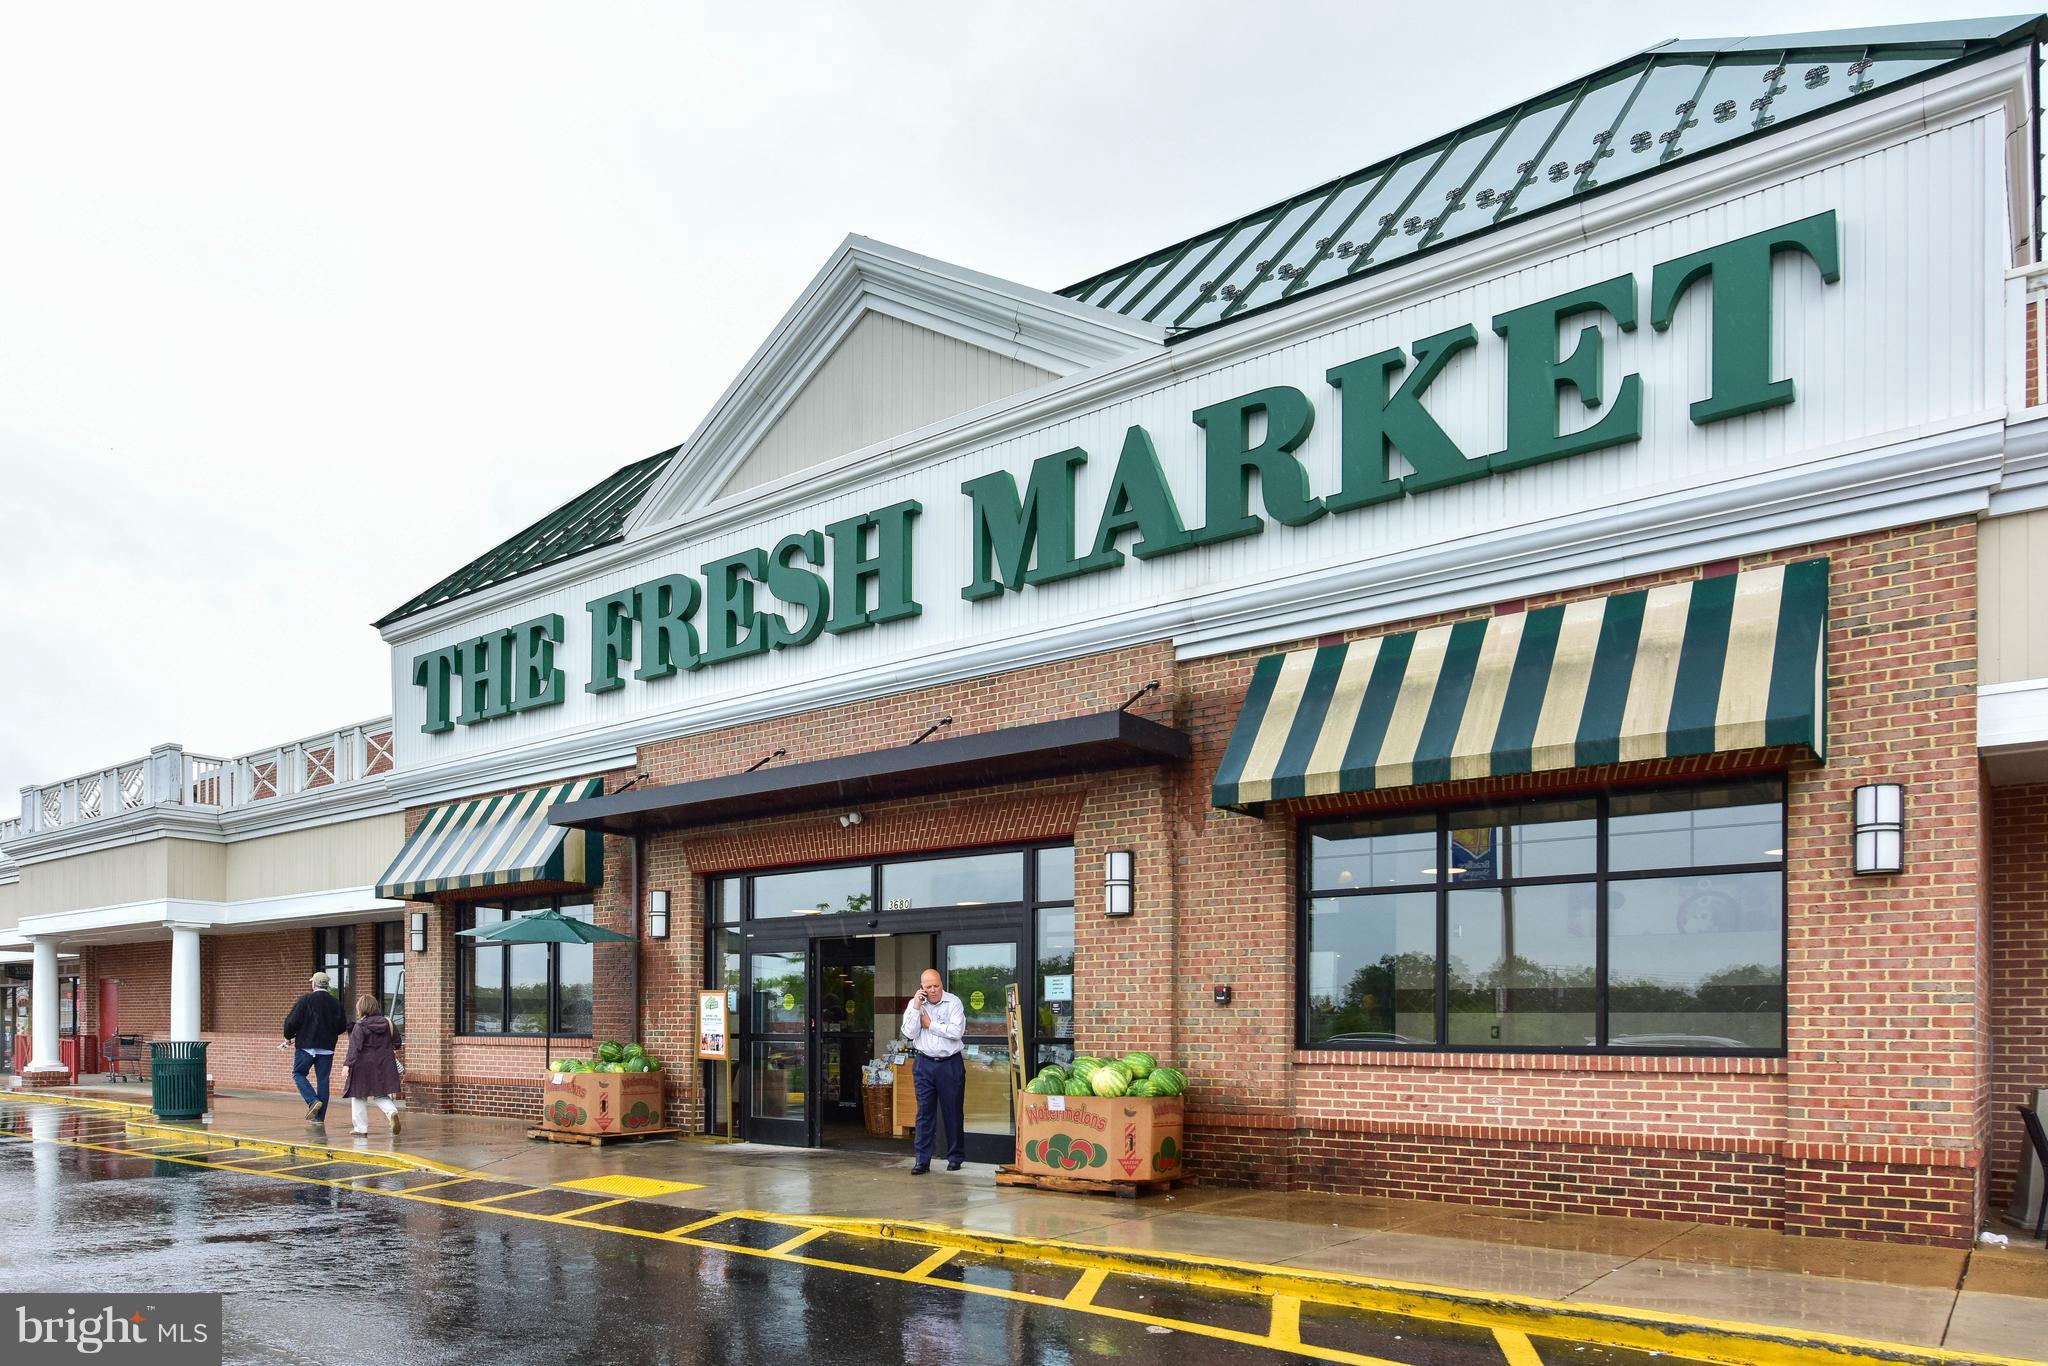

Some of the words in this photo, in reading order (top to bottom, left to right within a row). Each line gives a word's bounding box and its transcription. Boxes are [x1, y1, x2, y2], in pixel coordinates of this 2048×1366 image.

[413, 613, 564, 734] THE
[585, 499, 922, 694] FRESH
[961, 209, 1840, 601] MARKET
[889, 900, 910, 910] 3680
[1026, 1105, 1107, 1132] Watermelons
